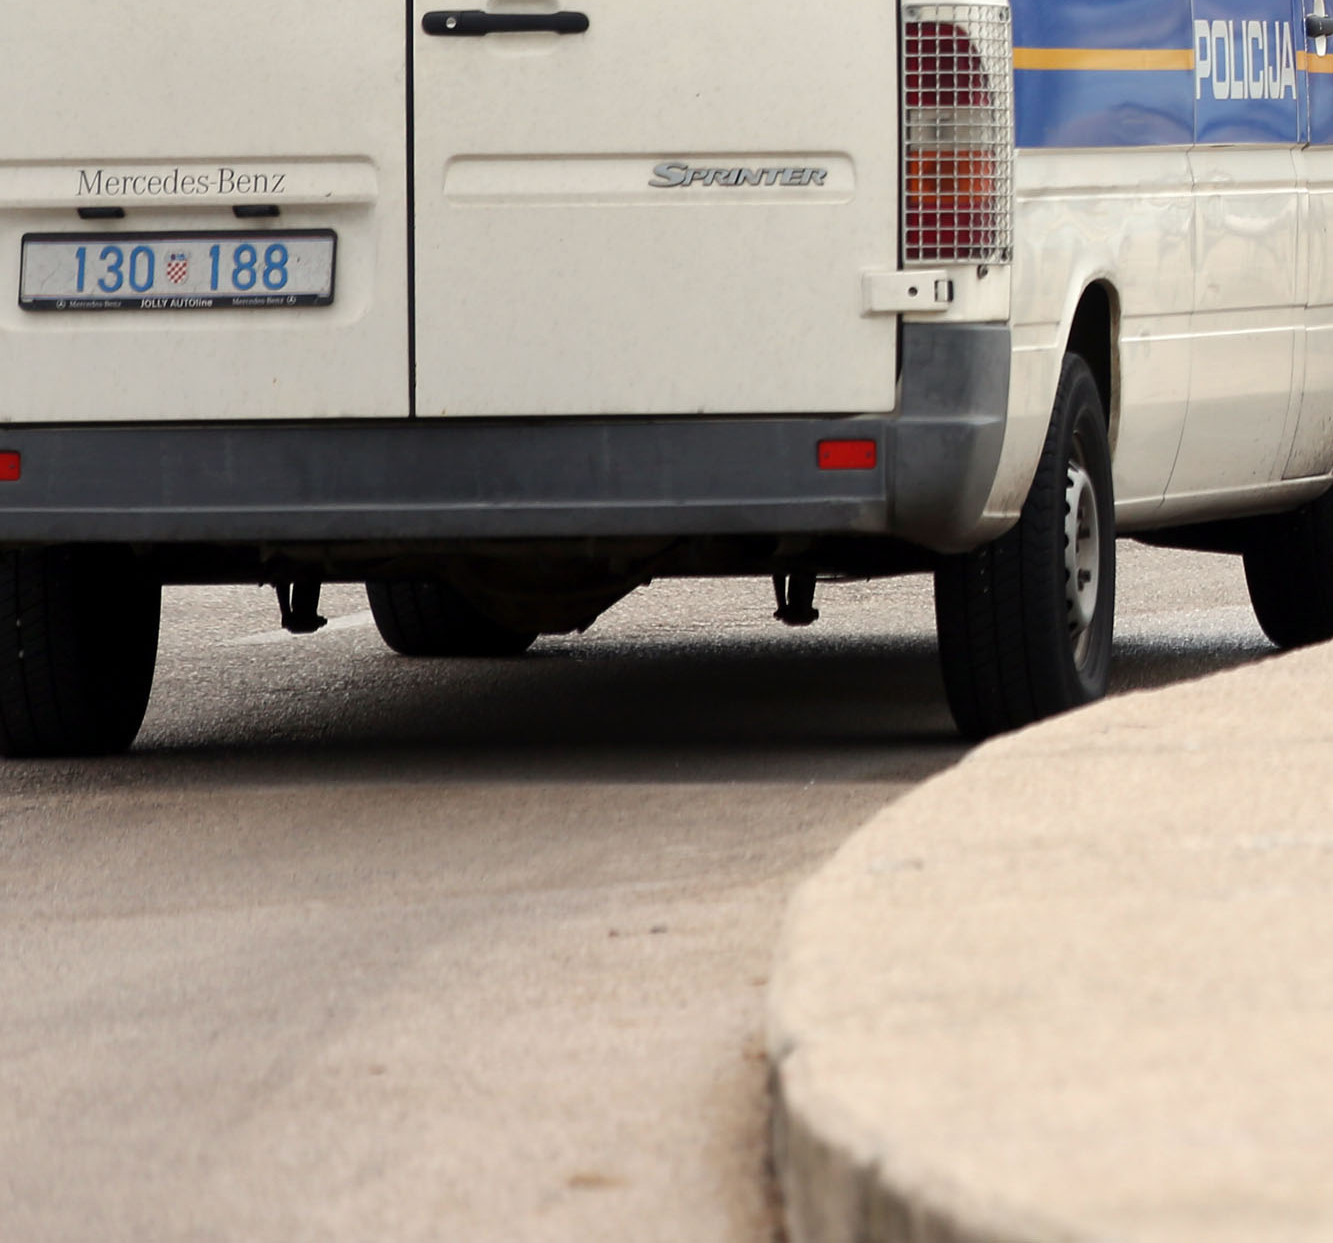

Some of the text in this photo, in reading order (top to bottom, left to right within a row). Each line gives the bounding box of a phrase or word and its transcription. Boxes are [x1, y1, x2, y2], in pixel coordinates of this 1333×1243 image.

[1195, 19, 1297, 100] POLICIJA
[75, 168, 286, 196] Mercedes-Benz
[75, 243, 289, 292] 130 188
[140, 299, 168, 309] JOLLY
